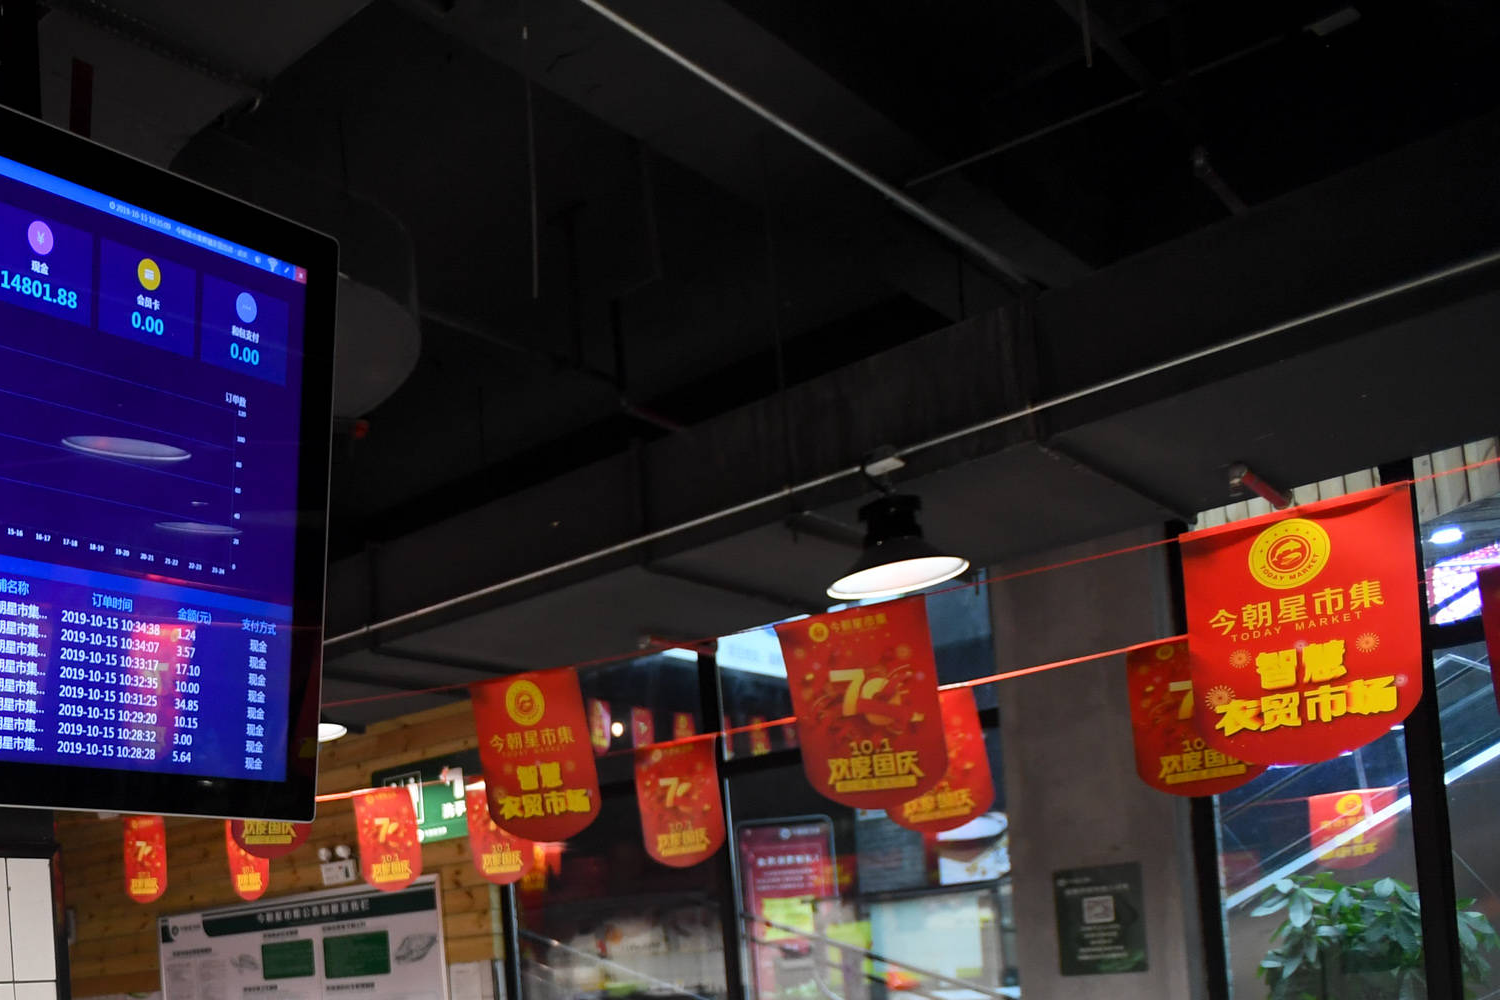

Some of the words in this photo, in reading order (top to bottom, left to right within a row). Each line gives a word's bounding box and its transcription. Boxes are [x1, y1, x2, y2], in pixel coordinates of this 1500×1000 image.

[31, 259, 49, 275] 现金
[0, 270, 78, 309] 14801.88
[136, 294, 160, 310] 会员卡
[132, 312, 164, 335] 0.00
[230, 342, 260, 365] 0.00
[92, 593, 133, 613] 订单时间
[177, 608, 212, 625] 金额(元)
[241, 618, 276, 636] 支付方式
[1209, 580, 1384, 635] 今朝星市集
[61, 609, 118, 631] 2019-10-15
[121, 617, 161, 636] 10:34:38
[177, 627, 196, 642] 1.24
[249, 639, 268, 653] 现金
[1231, 627, 1282, 642] TODAY
[1296, 611, 1362, 630] MARKET
[59, 666, 116, 685] 2019-10-15
[119, 672, 159, 690] 10:32:35
[1256, 640, 1347, 689] 智慧
[174, 697, 199, 713] 34.85
[1215, 675, 1397, 737] 农贸市场
[118, 709, 157, 726] 10:29:20
[173, 715, 198, 731] 10.15
[246, 723, 264, 737] 现金
[57, 740, 114, 759] 2019-10-15
[117, 746, 156, 761] 10:28:28
[172, 750, 191, 764] 5.64
[490, 726, 575, 753] 今朝星市集
[828, 751, 924, 784] 欢度国庆
[499, 789, 591, 820] 农贸市场
